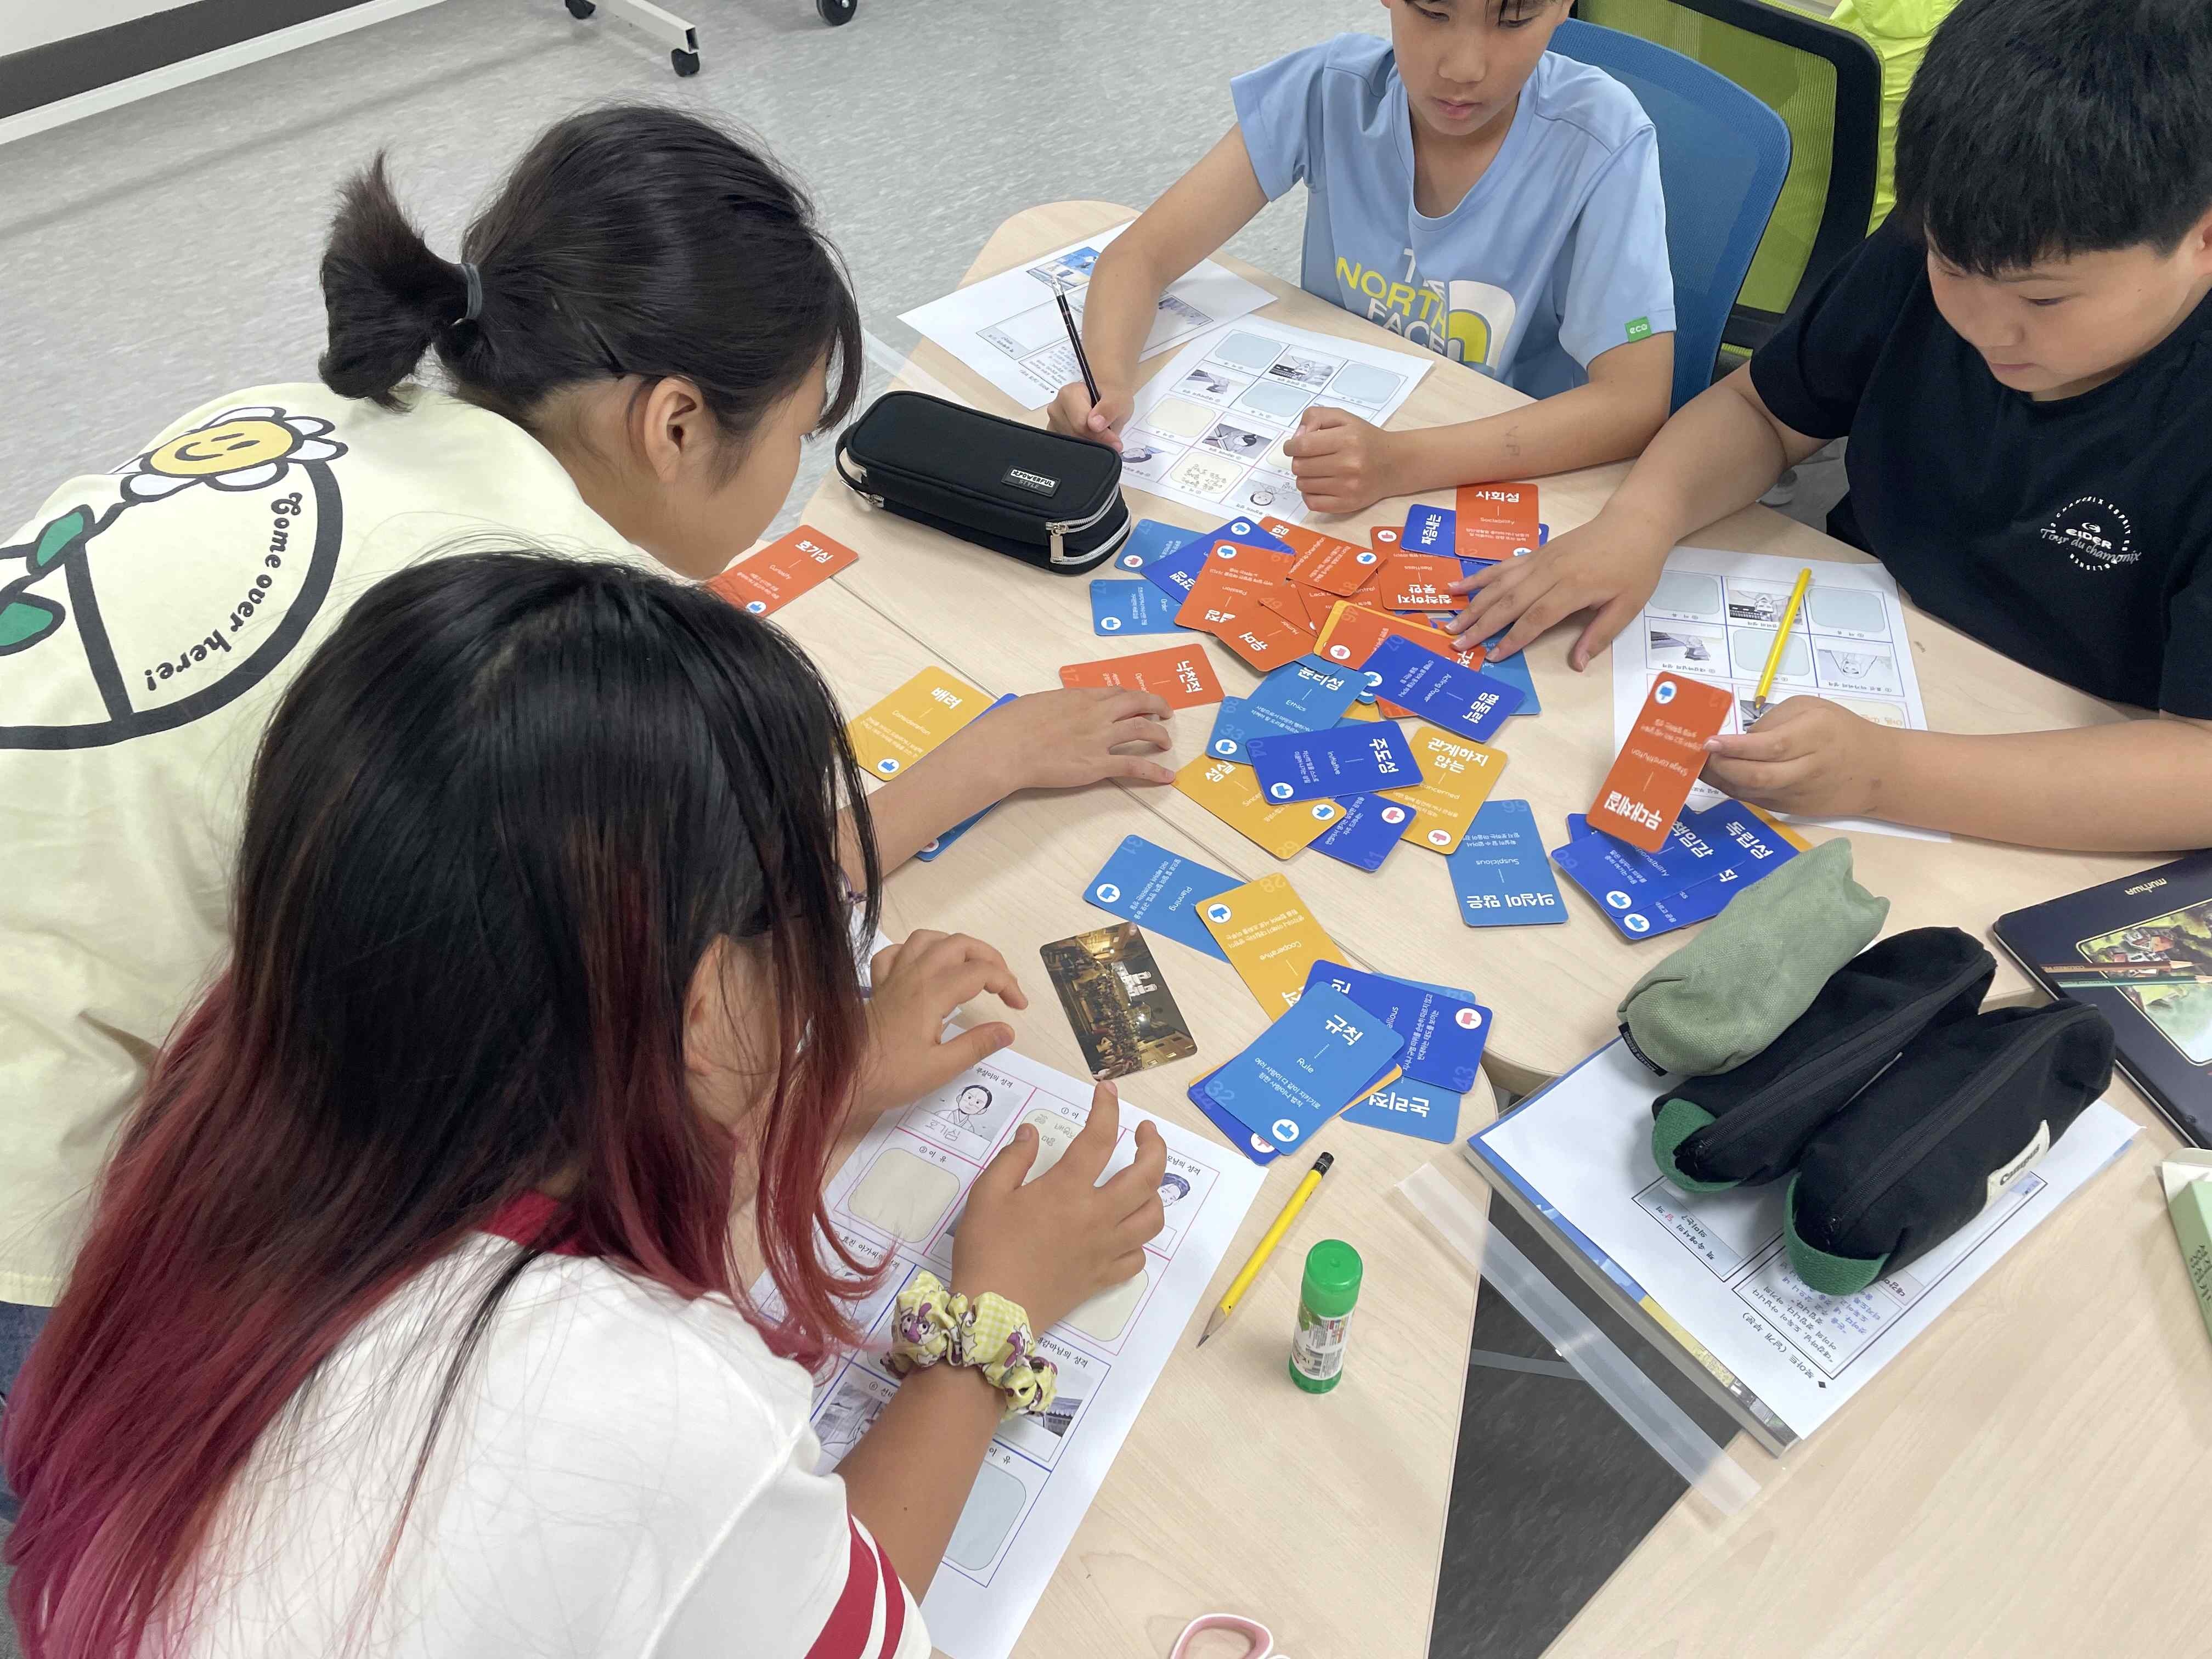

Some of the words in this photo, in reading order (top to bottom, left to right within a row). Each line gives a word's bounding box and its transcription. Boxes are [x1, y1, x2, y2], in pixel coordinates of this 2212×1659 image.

[1336, 256, 1447, 338] NORTH
[1629, 323, 1647, 334] eco
[1018, 471, 1053, 487] POWERFUL
[1018, 478, 1040, 489] STYLE
[1476, 491, 1520, 503] 사회성
[265, 492, 303, 569] Come
[1420, 514, 1442, 545] 짜증내는
[1480, 517, 1515, 525] Sociability
[2066, 528, 2112, 549] EIDER
[2071, 535, 2086, 549] du
[794, 539, 834, 564] 호기심
[1221, 585, 1248, 596] Passion
[1354, 585, 1376, 594] ontrol
[1408, 583, 1437, 594] 못한
[230, 574, 274, 633] over
[1160, 598, 1169, 612] Order
[1397, 594, 1452, 605] 침착하지
[1279, 620, 1301, 635] Humor
[1237, 631, 1269, 652] 유머
[145, 629, 232, 692] here!
[1134, 672, 1148, 693] Optimis
[1175, 660, 1203, 693] 낙천적
[1433, 672, 1452, 689] Acting
[929, 686, 963, 709] 배려
[1422, 686, 1440, 703] Power
[1284, 699, 1307, 713] Ethics
[1461, 691, 1500, 724] 행동력
[1368, 737, 1399, 774] 주도성
[1427, 737, 1489, 767] 관계하지
[1630, 747, 1670, 768] constitution
[1204, 759, 1237, 783] 성실
[1327, 751, 1341, 775] Initiative
[1433, 754, 1466, 774] 않는
[1667, 761, 1689, 777] Stage
[1603, 790, 1663, 831] 무대체질
[1664, 820, 1716, 859] 책임감
[1723, 820, 1776, 860] 독립성
[1475, 857, 1520, 866] Suspicious
[1167, 885, 1193, 912] Planning
[1465, 894, 1502, 909] 많은
[1504, 892, 1555, 908] 의심이
[1258, 940, 1302, 961] Cooperative
[1324, 1013, 1364, 1046] 규칙
[1295, 1057, 1315, 1074] Rule
[1450, 1065, 1475, 1090] 43
[1205, 1079, 1237, 1108] 32
[1368, 1086, 1431, 1118] 논리적
[1071, 1111, 1080, 1120] 이
[923, 1116, 962, 1143] 호기심
[928, 1149, 937, 1159] 이
[939, 1154, 947, 1164] 유
[1165, 1154, 1186, 1169] 모님의
[1186, 1164, 1201, 1176] 성격
[1680, 1211, 1708, 1238] 의미는?
[1882, 1274, 1906, 1297] 대감마
[1741, 1311, 1764, 1333] 부분)
[1779, 1312, 1802, 1333] 도둑이
[1073, 1355, 1089, 1369] 성격
[1788, 1353, 1815, 1379] 북아트
[988, 1447, 998, 1457] 이
[1002, 1454, 1012, 1465] 유
